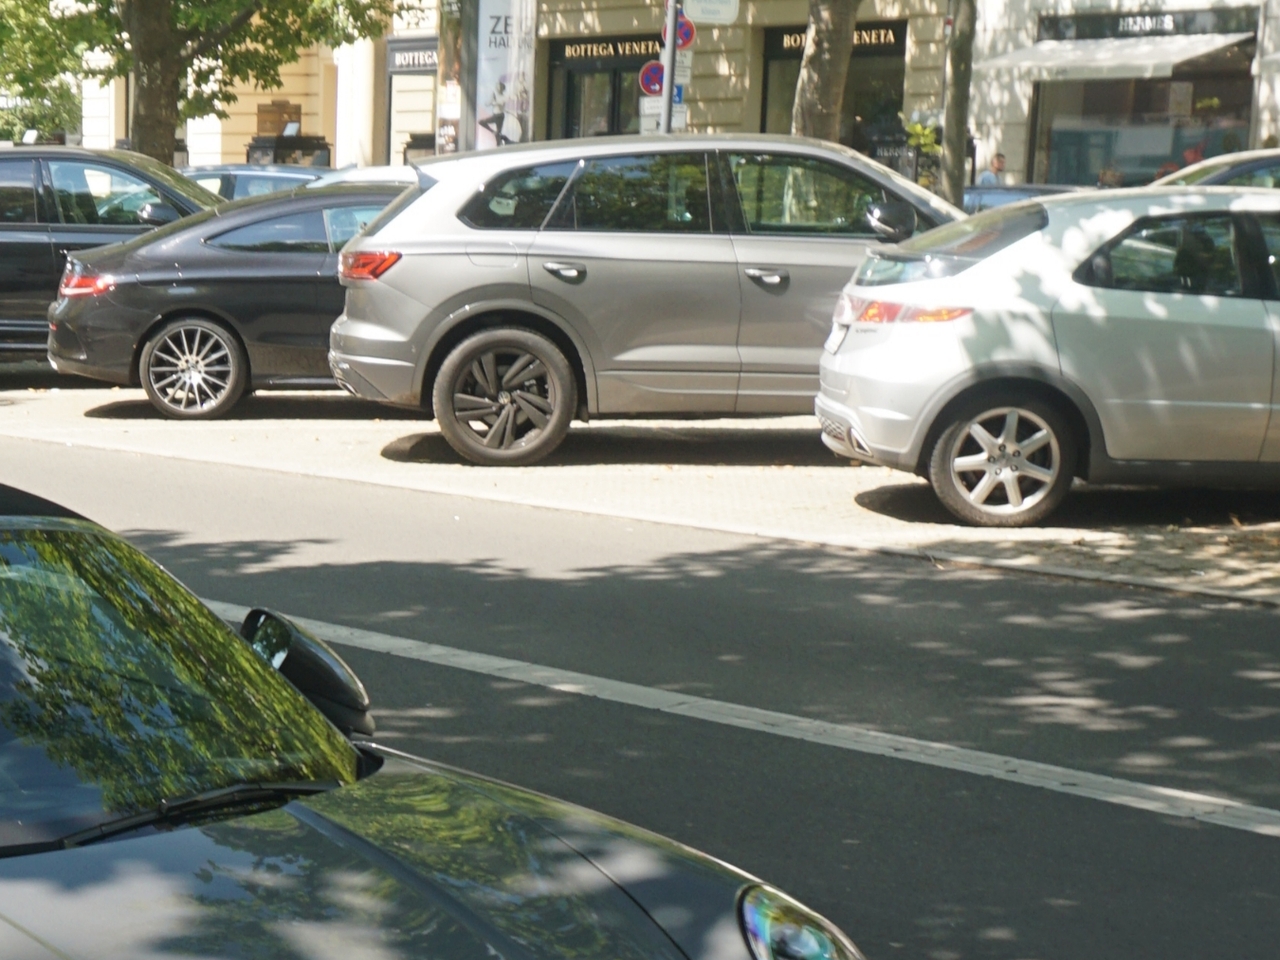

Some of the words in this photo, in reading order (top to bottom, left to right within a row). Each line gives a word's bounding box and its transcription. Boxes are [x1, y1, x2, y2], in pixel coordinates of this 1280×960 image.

[853, 29, 895, 44] ENETA
[565, 43, 615, 57] BOTTEGA
[617, 41, 661, 55] VENETA
[395, 51, 438, 66] BOTTEGA
